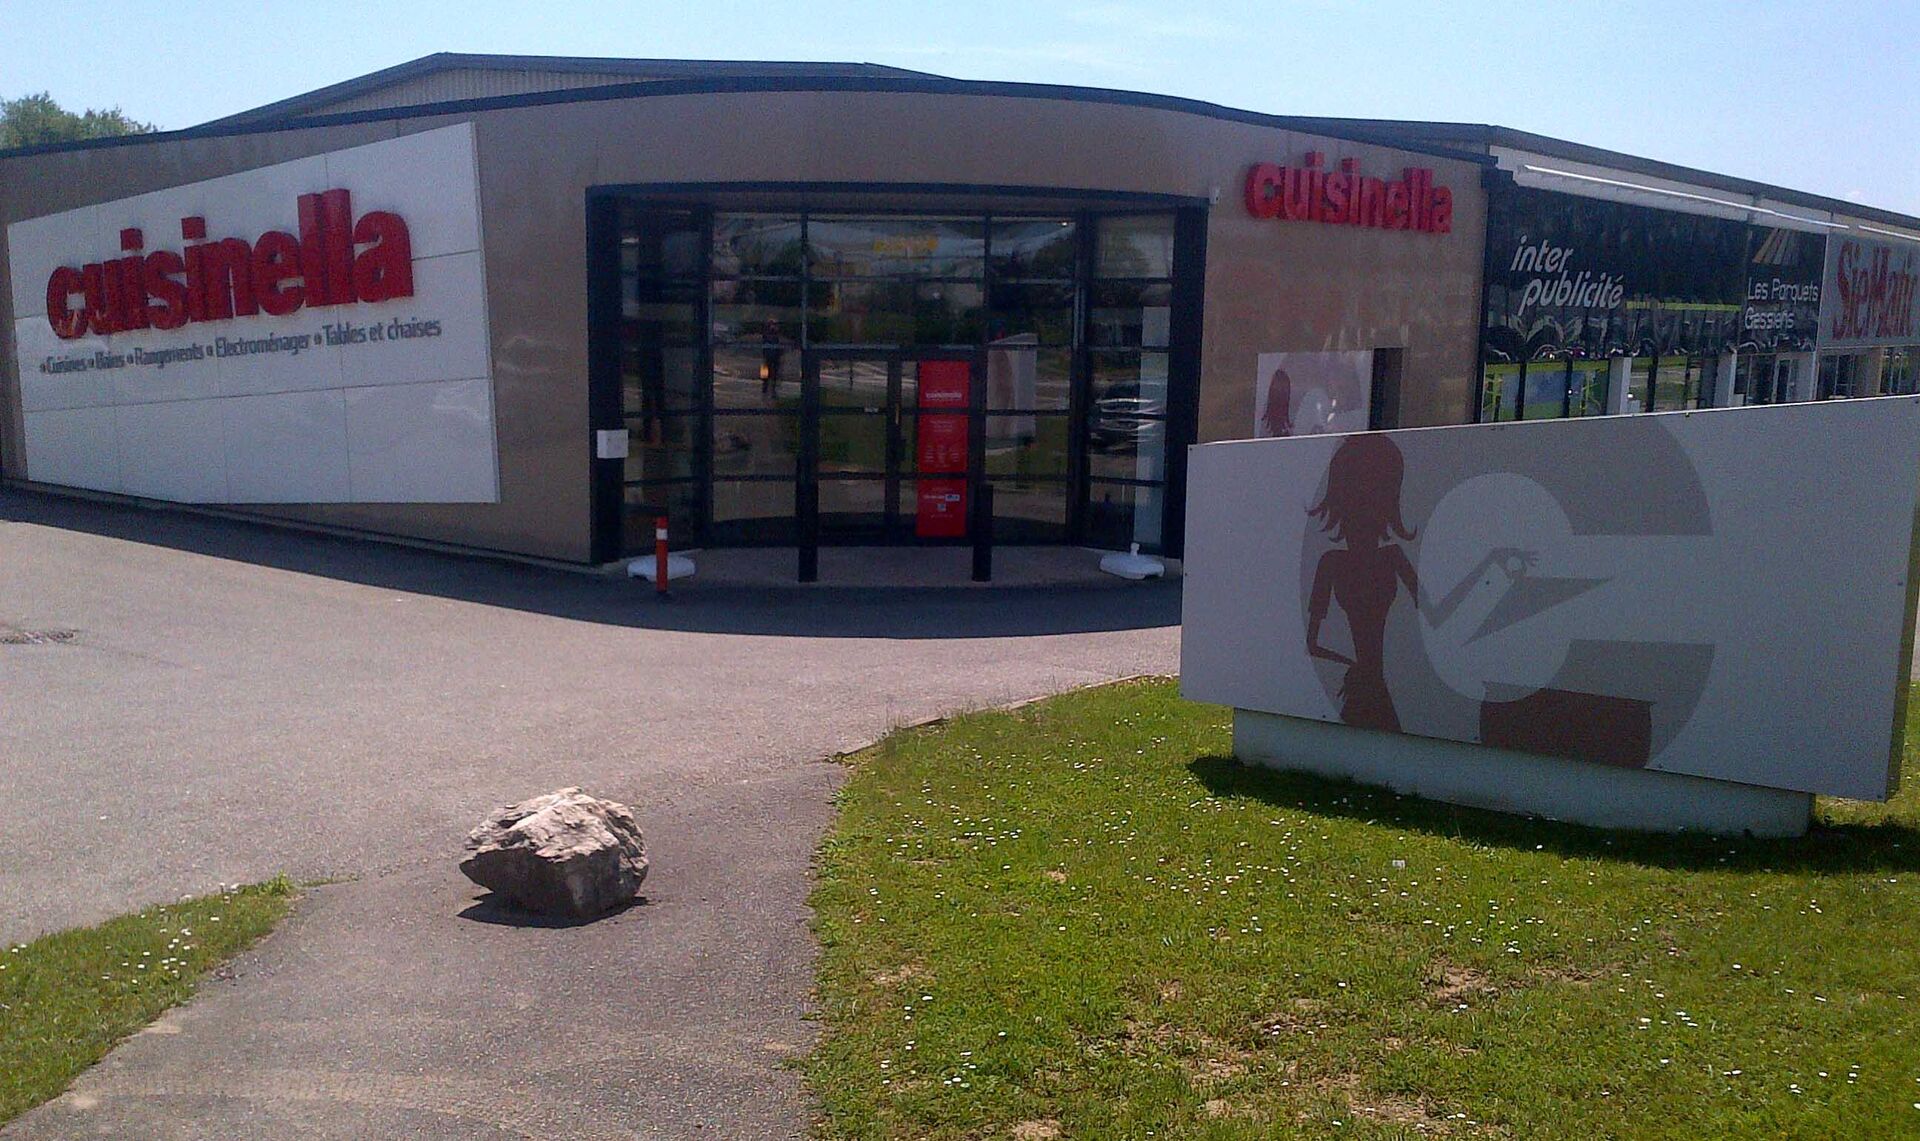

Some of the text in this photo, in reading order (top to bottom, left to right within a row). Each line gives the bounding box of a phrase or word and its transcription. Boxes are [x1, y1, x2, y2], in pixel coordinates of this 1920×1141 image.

[1244, 151, 1453, 233] cuisinella
[46, 188, 414, 339] cuisinella
[1510, 234, 1574, 272] inter
[1518, 270, 1624, 317] publicité
[1747, 276, 1819, 305] Les Parquets
[135, 342, 204, 369] Rangements
[215, 332, 311, 358] Electroménager
[322, 322, 366, 347] Tables
[369, 322, 384, 341] et
[387, 316, 442, 341] chaises
